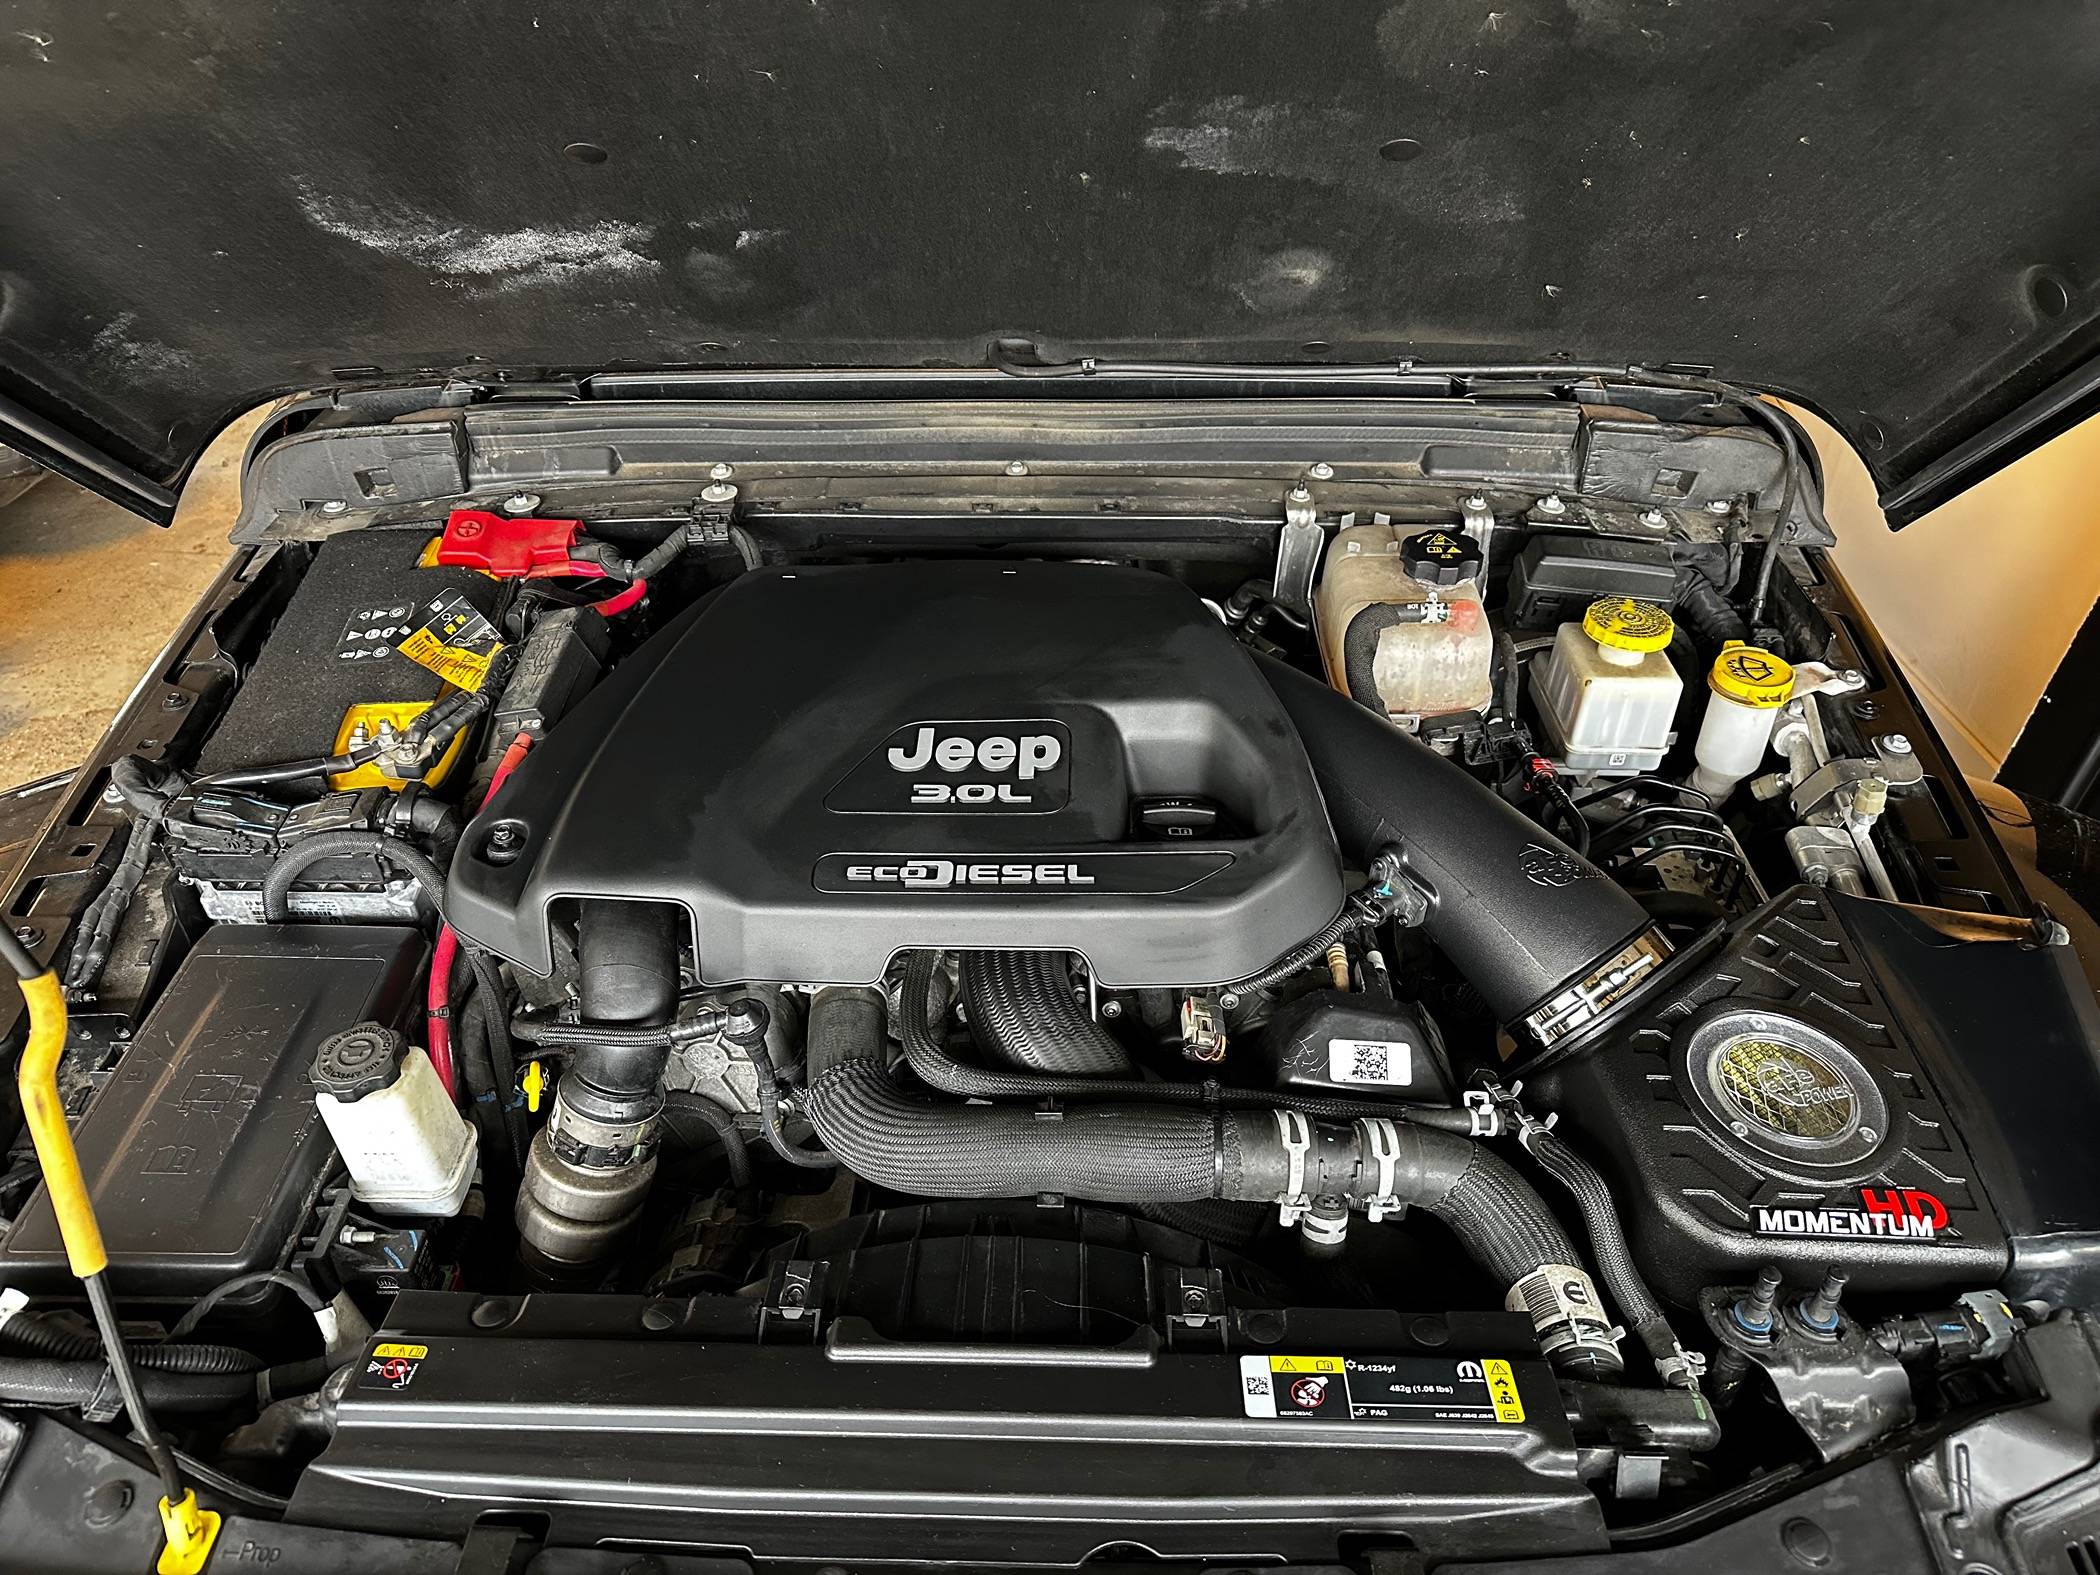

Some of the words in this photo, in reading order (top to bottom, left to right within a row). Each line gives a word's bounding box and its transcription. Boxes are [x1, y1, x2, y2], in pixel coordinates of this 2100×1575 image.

[888, 728, 1061, 780] Jeep
[911, 784, 1032, 804] 3.0L
[1799, 1085, 1854, 1107] POWER
[1758, 1209, 1935, 1237] MOMENTUM
[1861, 1189, 1949, 1230] HD
[239, 1540, 281, 1568] Prop
